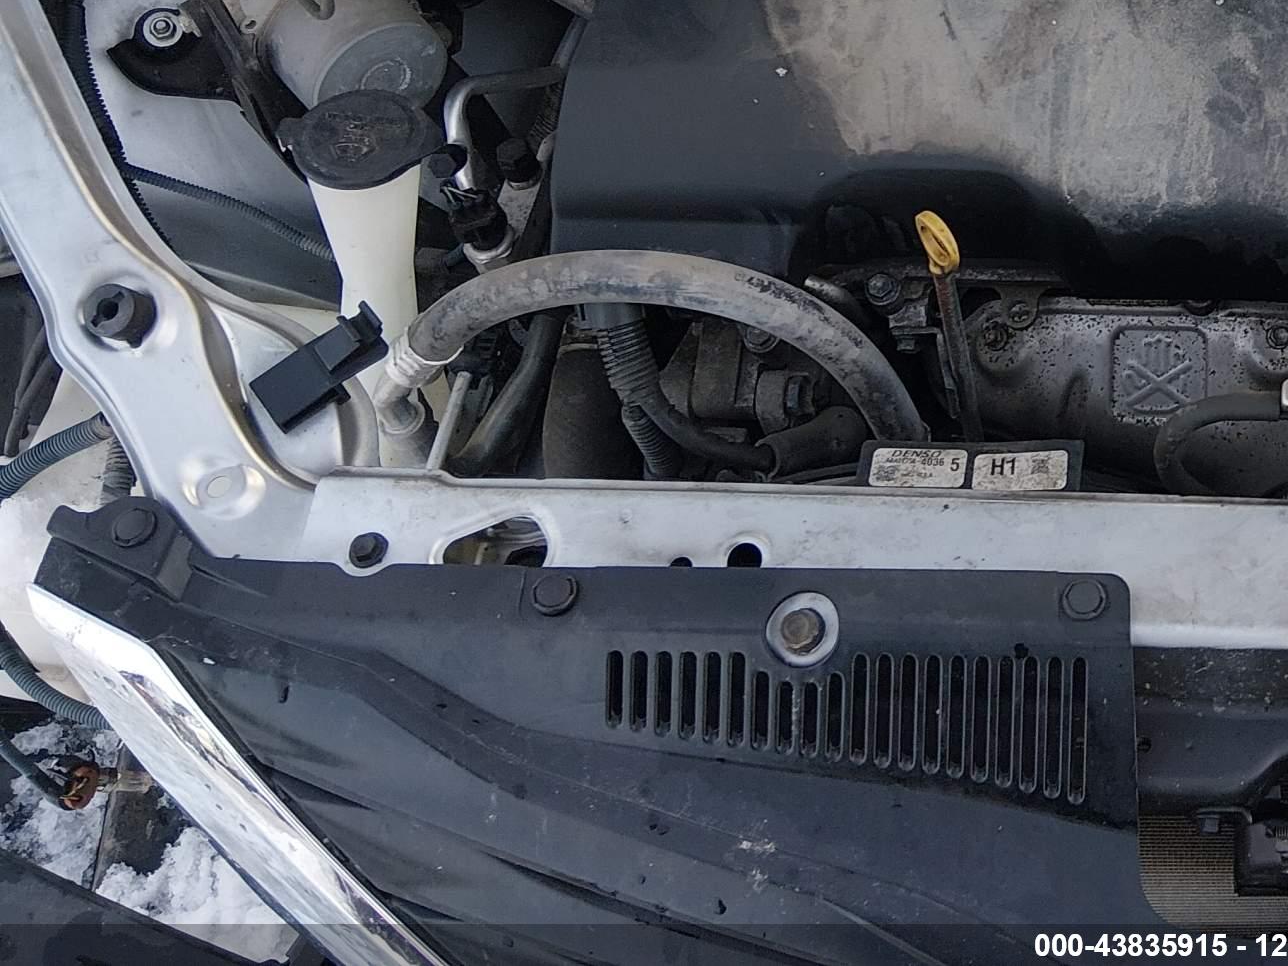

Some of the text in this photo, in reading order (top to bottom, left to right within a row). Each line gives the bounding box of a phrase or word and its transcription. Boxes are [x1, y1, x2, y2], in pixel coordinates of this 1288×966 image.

[891, 449, 942, 458] DENSO
[950, 457, 960, 472] 5
[990, 457, 1016, 475] H1
